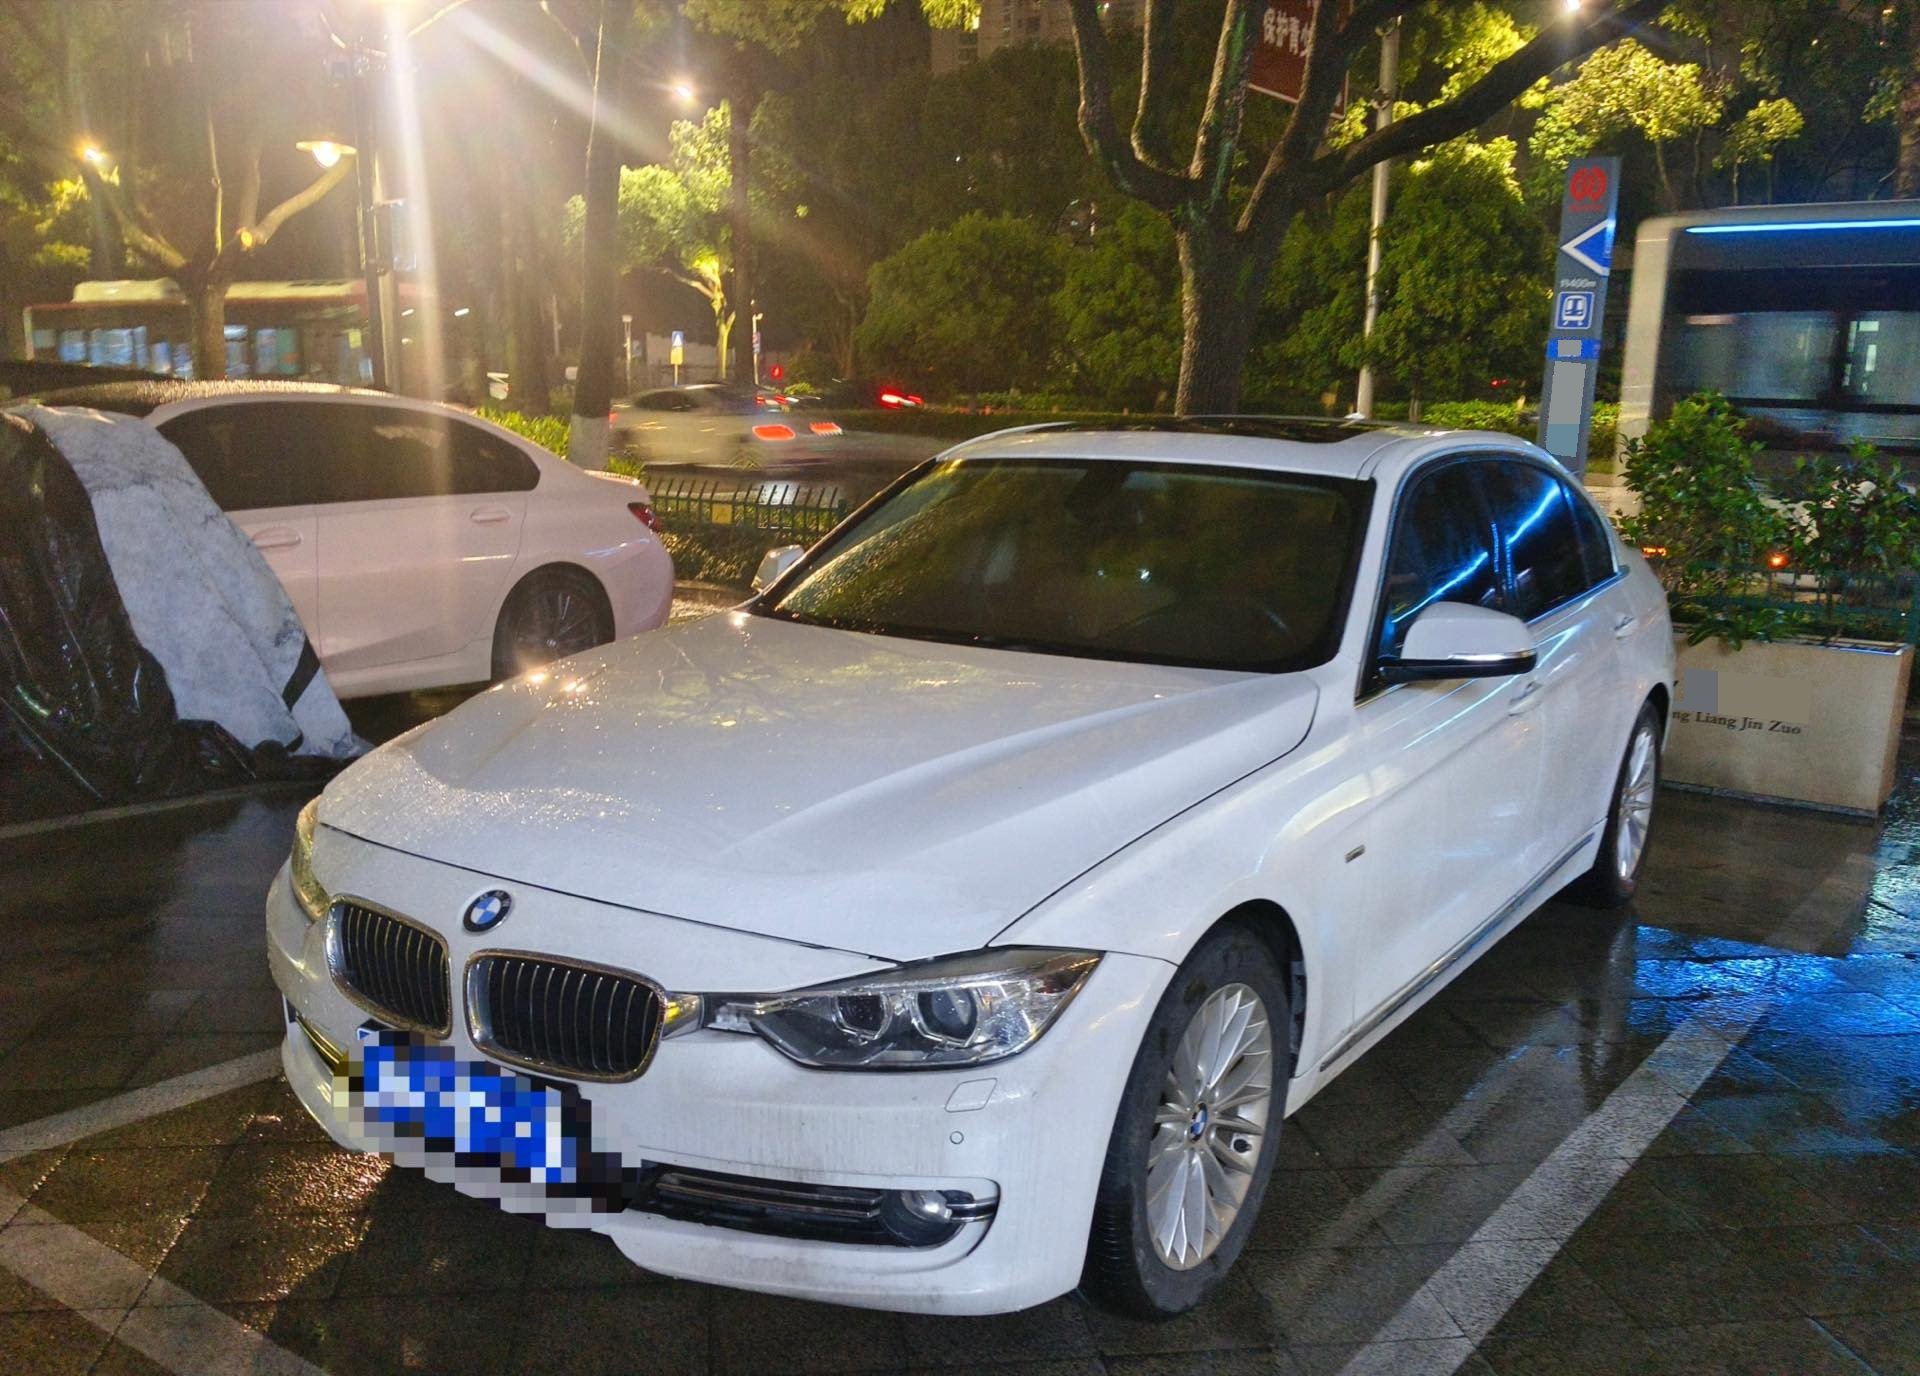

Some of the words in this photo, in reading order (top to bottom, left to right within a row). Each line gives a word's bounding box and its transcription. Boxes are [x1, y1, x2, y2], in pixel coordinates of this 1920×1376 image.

[1695, 711, 1737, 729] Liang
[1738, 717, 1763, 731] Jin
[1768, 720, 1802, 735] Zuo
